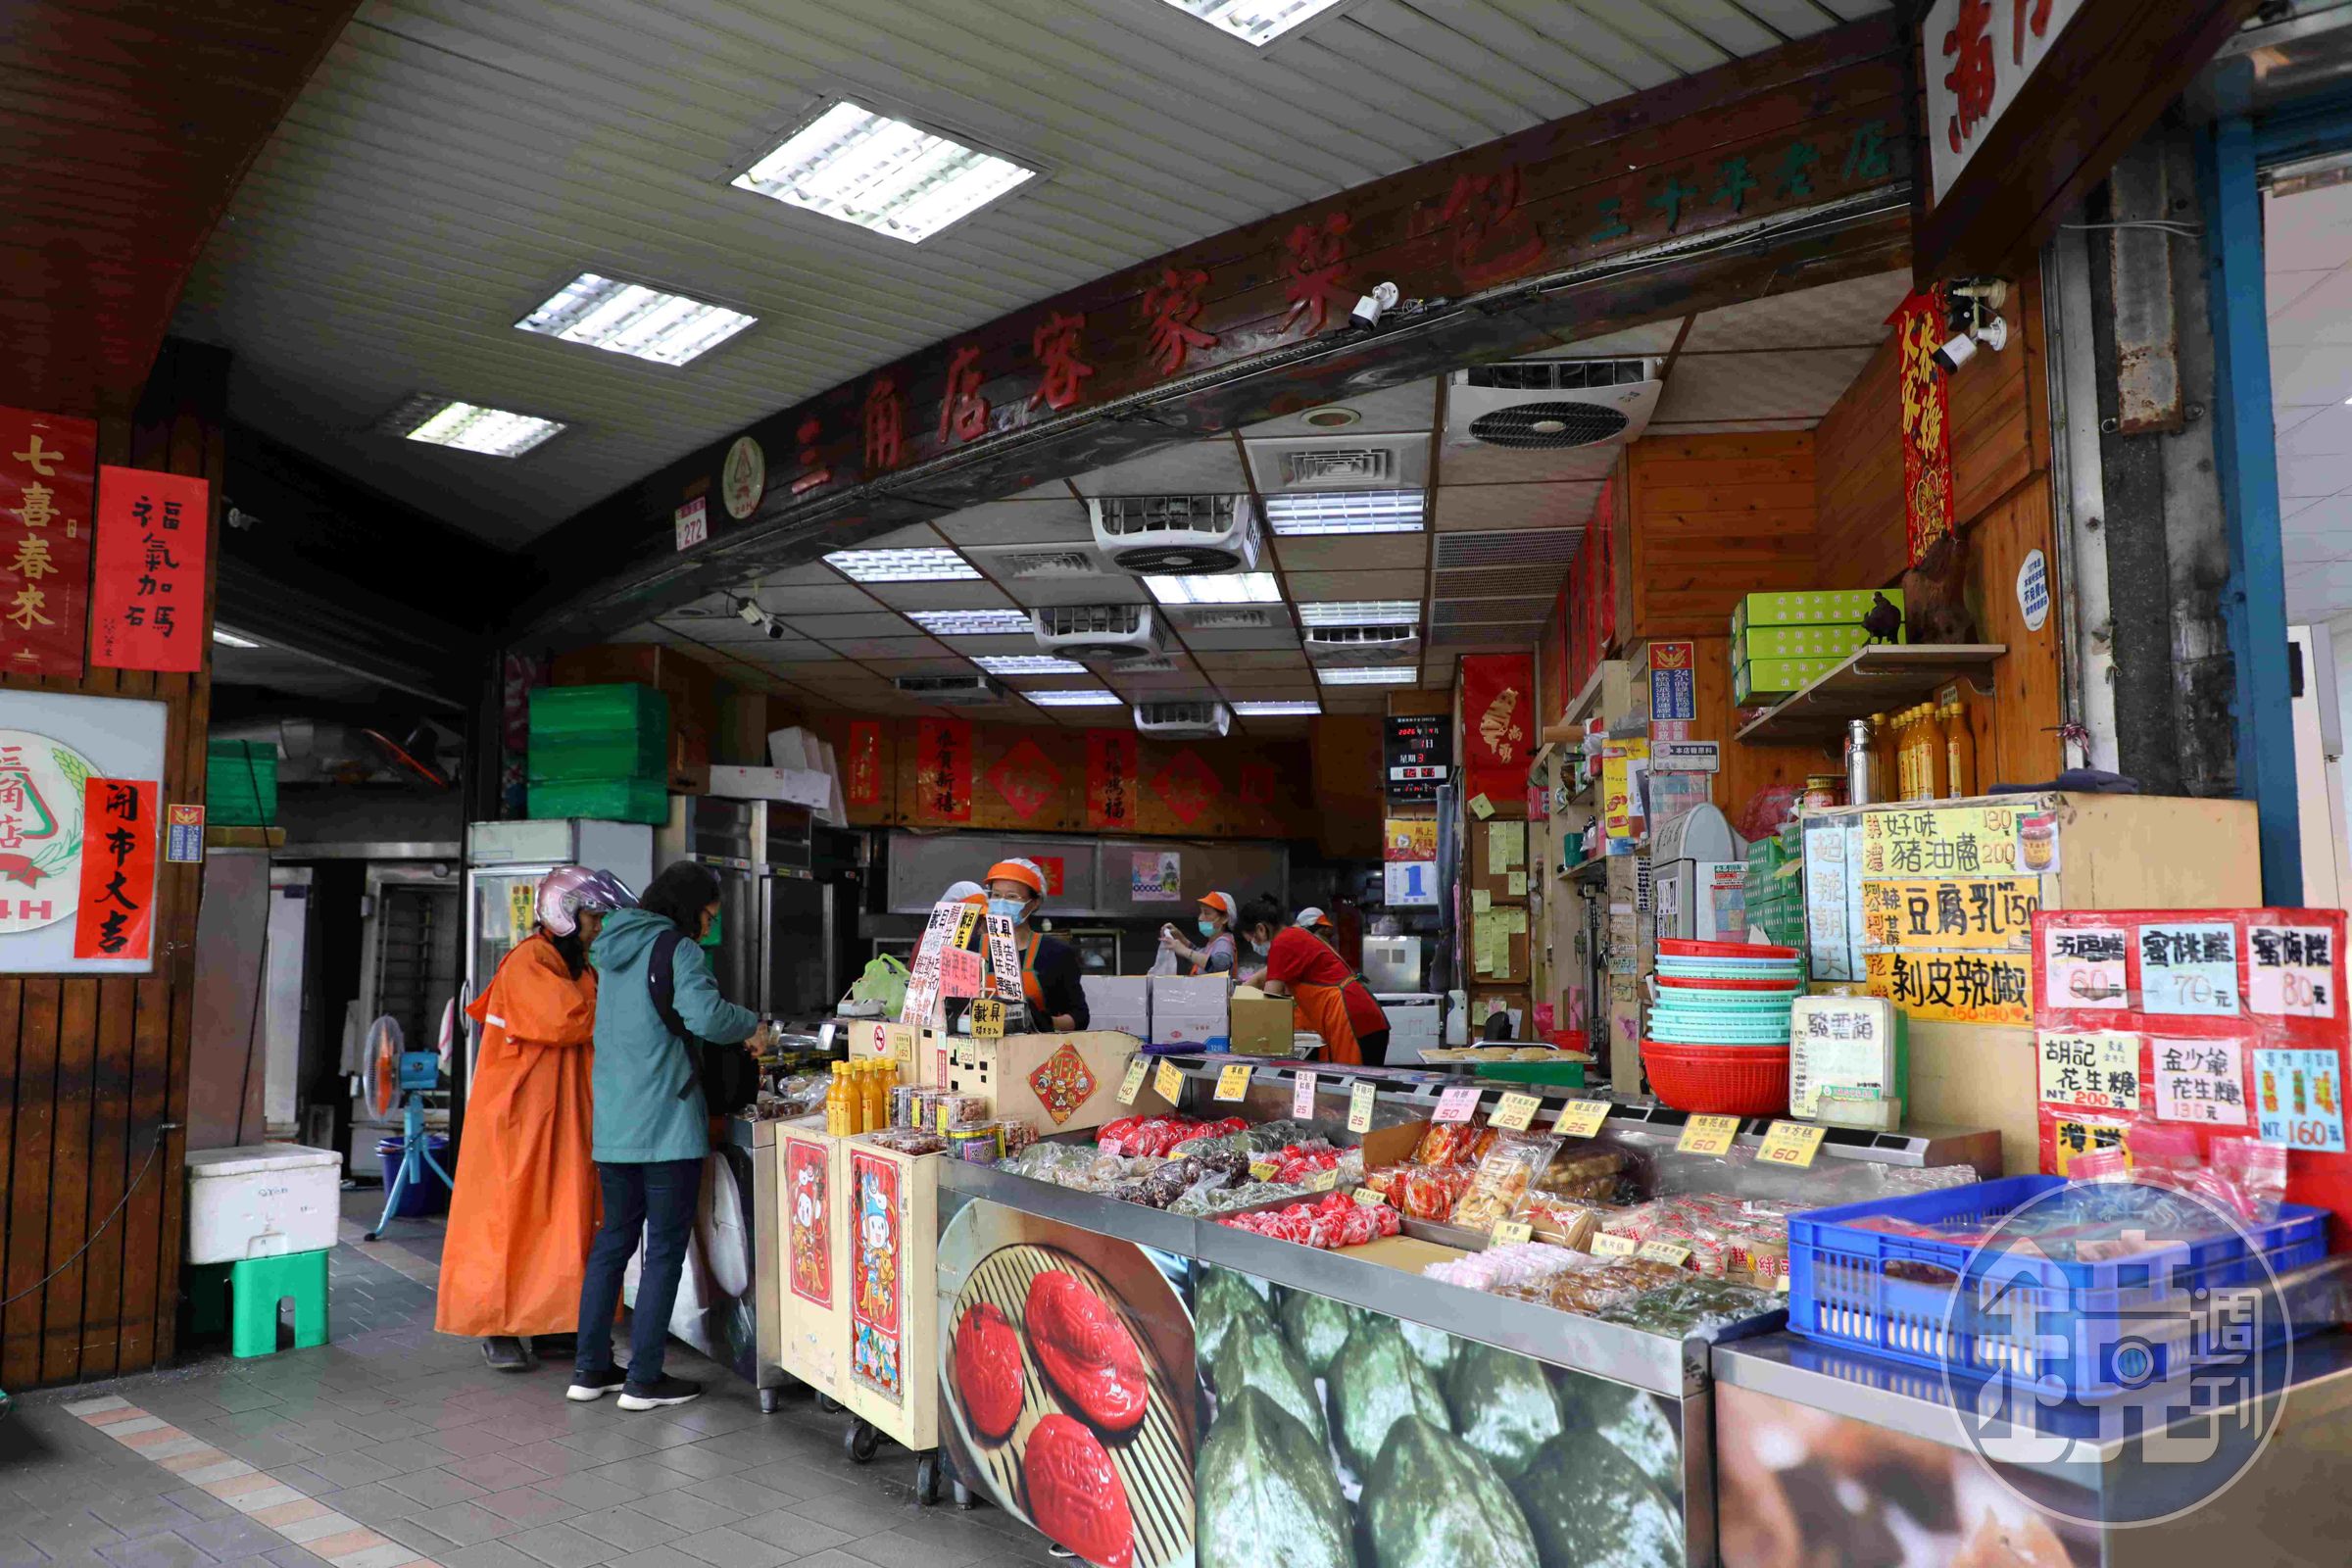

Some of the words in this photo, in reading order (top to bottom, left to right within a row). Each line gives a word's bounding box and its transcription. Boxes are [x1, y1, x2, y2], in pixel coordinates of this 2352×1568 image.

[7, 434, 65, 631] 七喜春來
[684, 519, 702, 545] 272
[125, 495, 183, 638] 福氣加碼
[1884, 810, 1937, 837] 好味
[1983, 842, 2016, 866] 200
[94, 784, 139, 954] 開市大吉
[1405, 865, 1427, 897] 1
[1906, 882, 2005, 935] 豆腐乳
[1891, 954, 2028, 1009] 剝皮辣椒
[974, 1003, 1001, 1023] 載具
[2045, 1039, 2096, 1067] 胡記
[2162, 1047, 2229, 1076] 金少爺
[2056, 1067, 2137, 1098] 花生糖
[2172, 1077, 2242, 1105] 花生糖
[1296, 1104, 1307, 1114] 25
[1351, 1115, 1365, 1126] 25
[1440, 1108, 1459, 1119] 50
[1498, 1113, 1523, 1126] 120
[1567, 1122, 1589, 1132] 25
[1691, 1140, 1716, 1151] 60
[1772, 1149, 1799, 1161] 60
